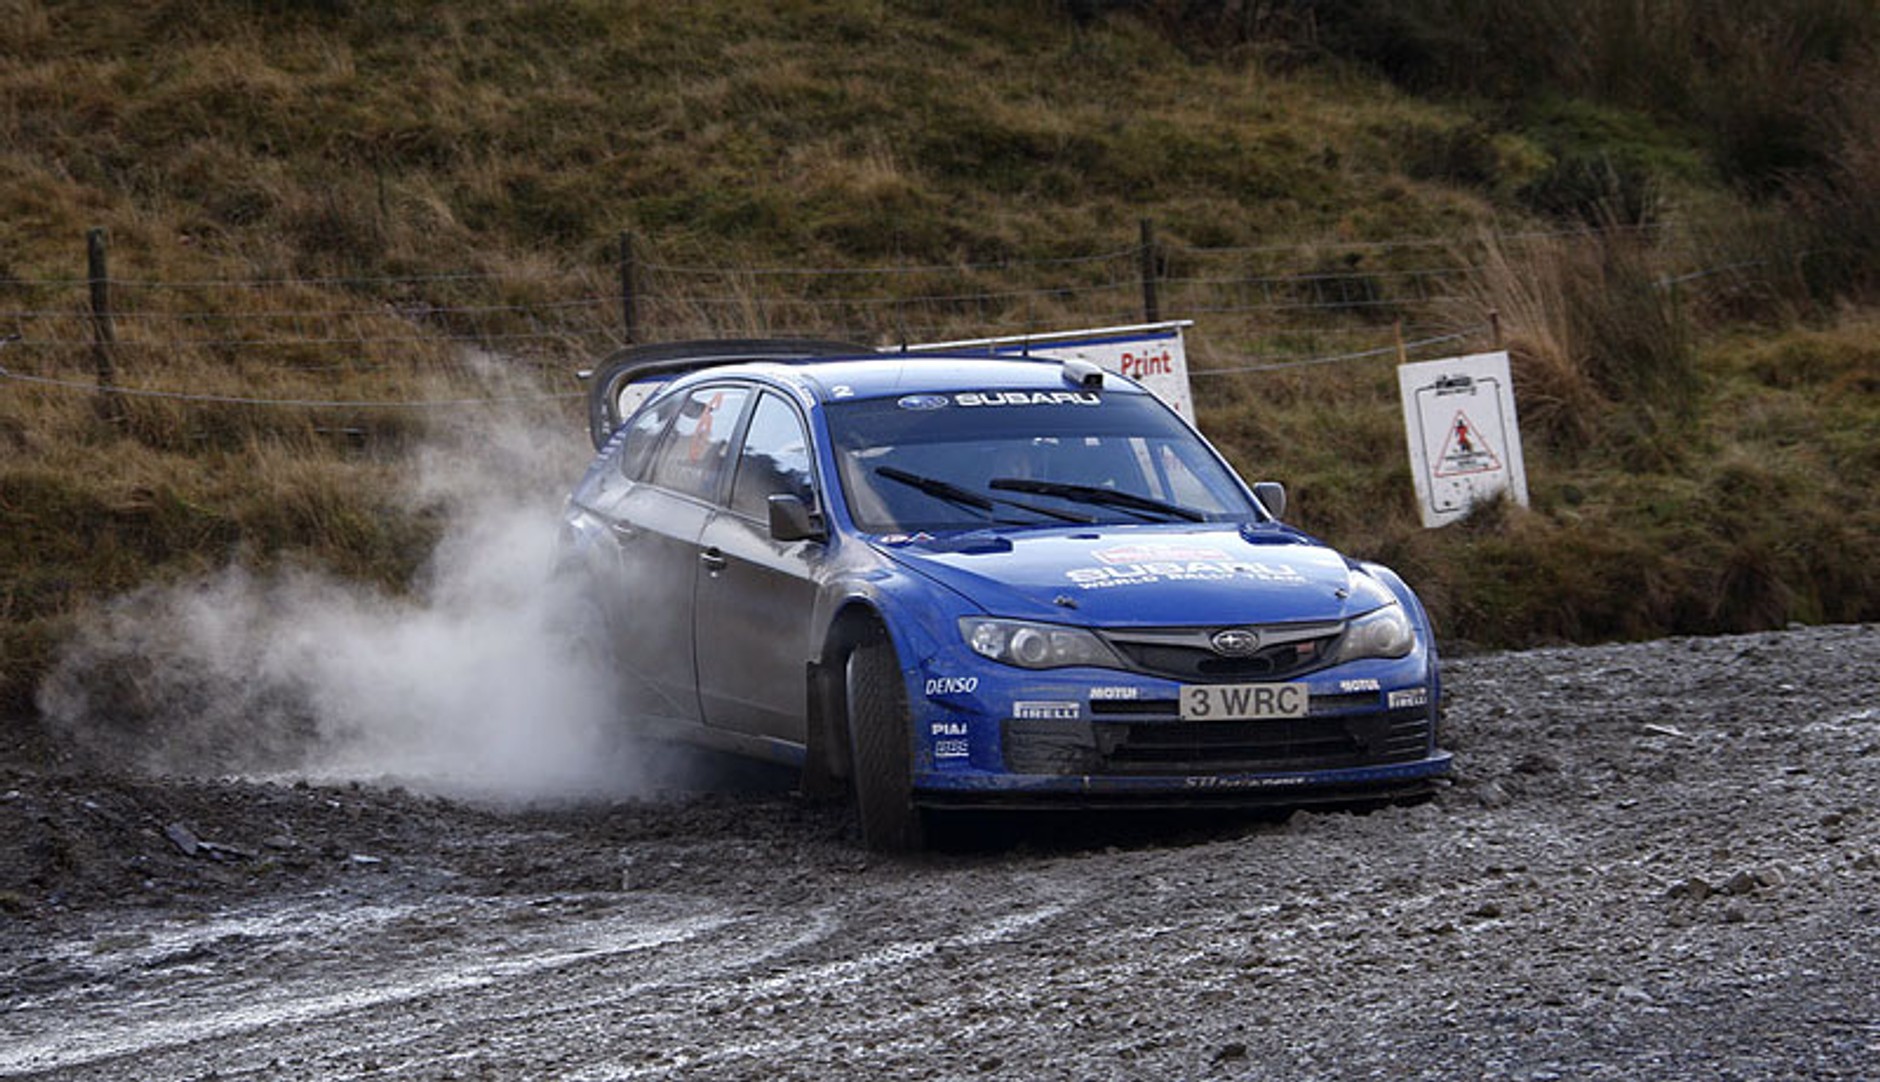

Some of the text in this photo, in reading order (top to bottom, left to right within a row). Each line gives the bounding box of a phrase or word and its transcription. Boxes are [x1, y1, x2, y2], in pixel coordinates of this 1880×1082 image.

[1121, 350, 1172, 376] Print
[832, 385, 854, 398] 2
[954, 392, 1101, 407] SUBARU
[1065, 562, 1297, 583] SUBARU
[1078, 576, 1158, 589] WORLD
[926, 677, 978, 695] DENSO
[1013, 701, 1080, 719] PIRELLI
[1190, 686, 1300, 717] 3 WRC
